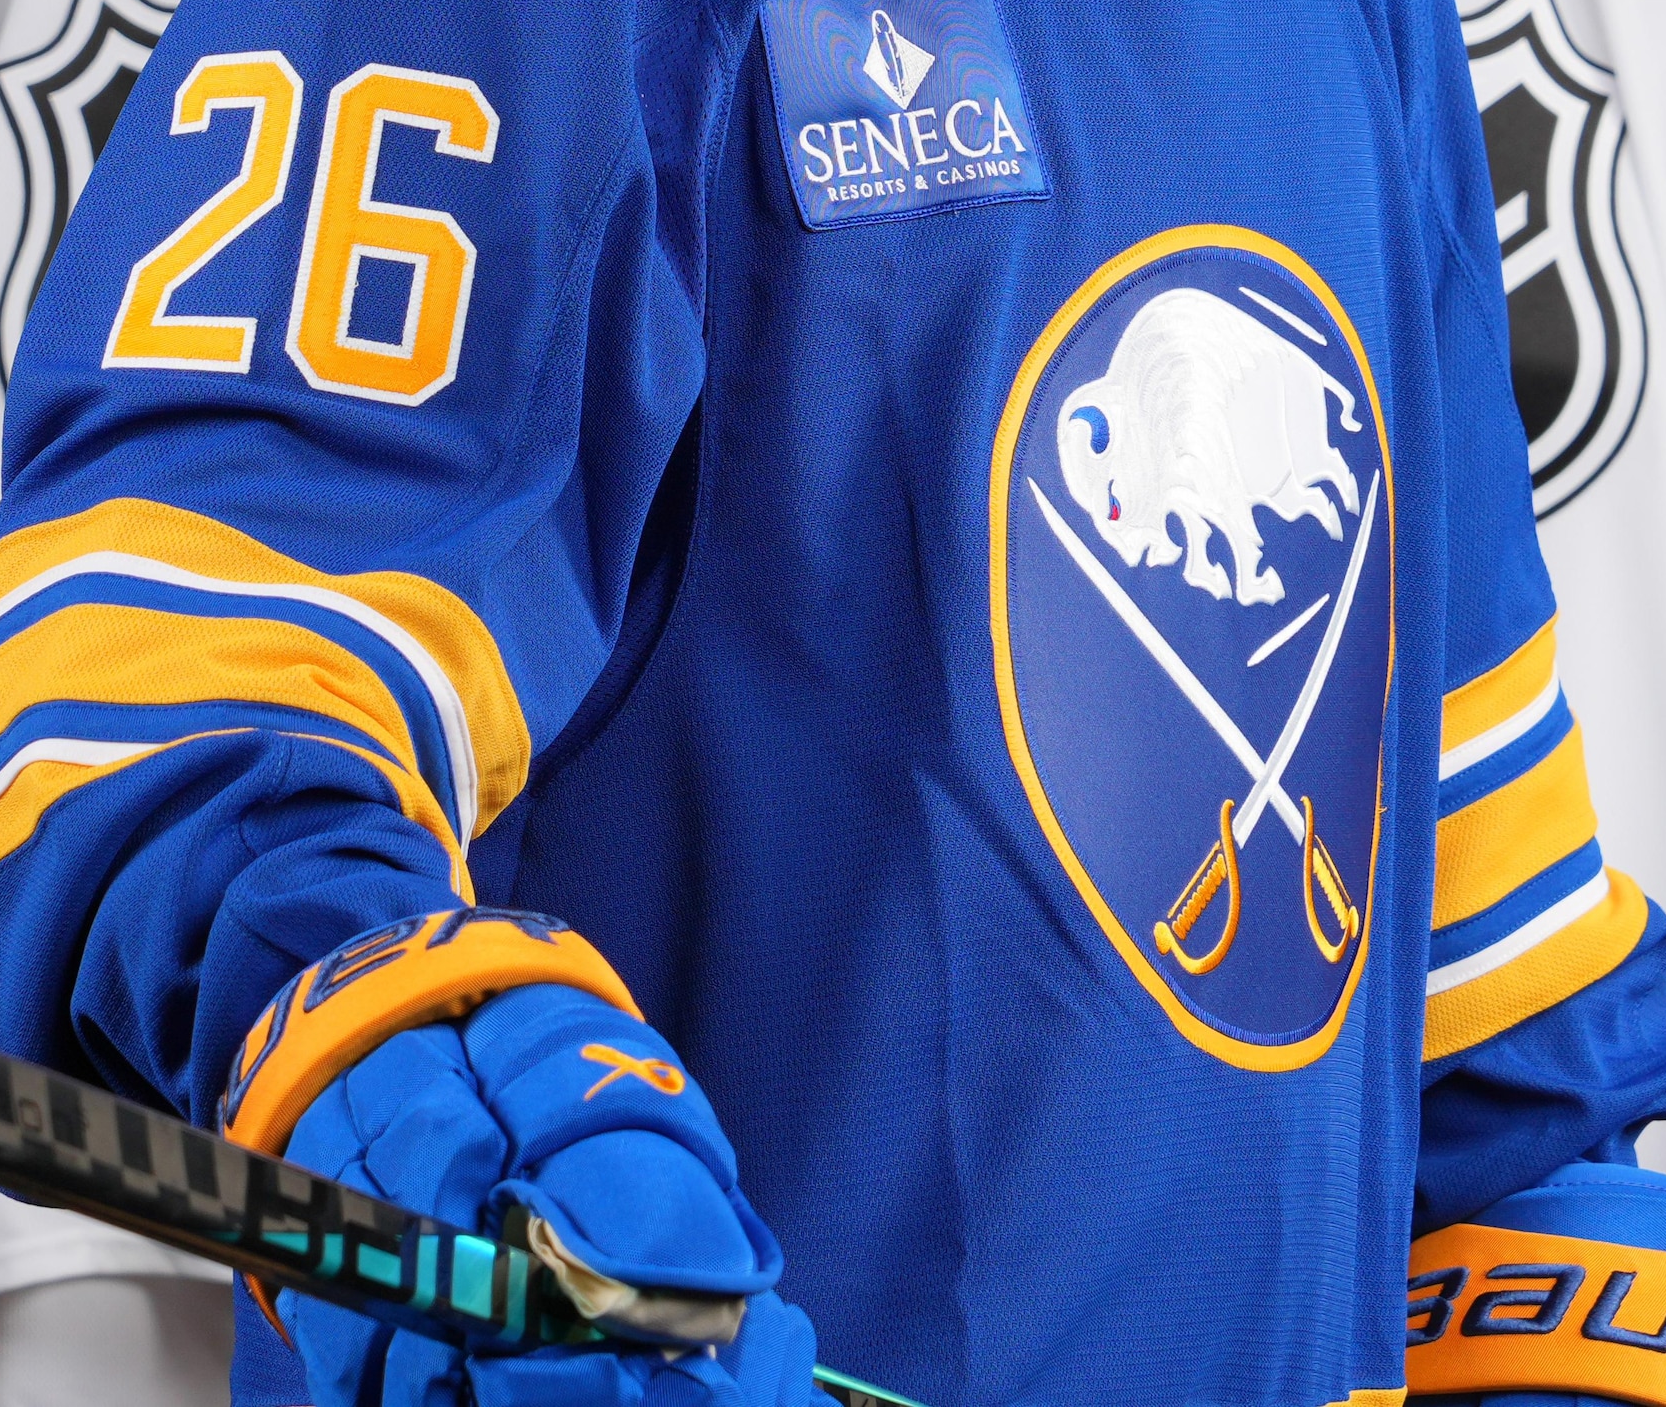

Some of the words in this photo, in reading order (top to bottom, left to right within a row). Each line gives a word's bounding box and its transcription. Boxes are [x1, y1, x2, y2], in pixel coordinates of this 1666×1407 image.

[799, 97, 1026, 183] SENECA
[827, 178, 906, 202] RESORTS
[915, 175, 929, 190] &
[937, 159, 1020, 186] CASINOS
[101, 50, 500, 407] 26
